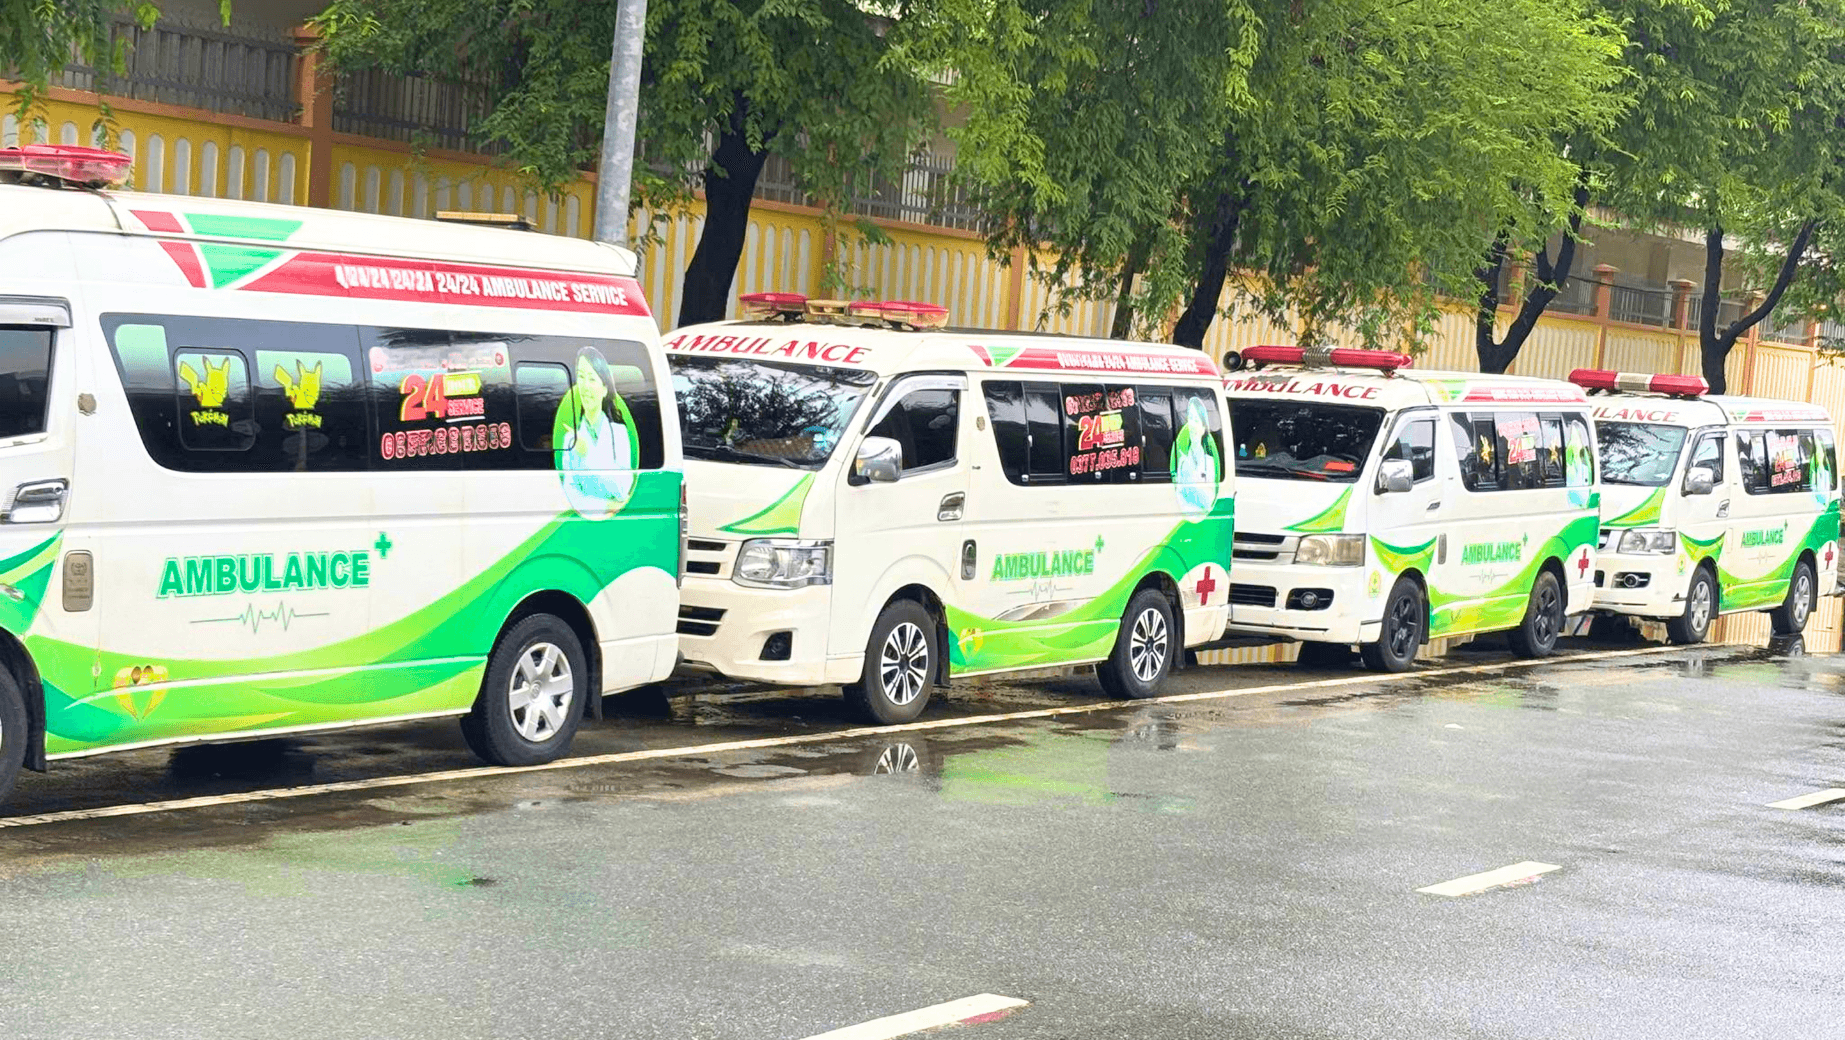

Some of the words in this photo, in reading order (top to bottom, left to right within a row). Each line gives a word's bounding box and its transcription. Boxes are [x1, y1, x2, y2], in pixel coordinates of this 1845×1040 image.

[437, 273, 480, 296] 24/24
[483, 276, 570, 302] AMBULANCE
[573, 287, 628, 306] SERVICE
[663, 334, 872, 364] AMBULANCE
[400, 373, 447, 422] 24
[1078, 415, 1104, 451] 24
[990, 549, 1094, 582] AMBULANCE
[1461, 542, 1521, 566] AMBULANCE
[156, 550, 370, 599] AMBULANCE
